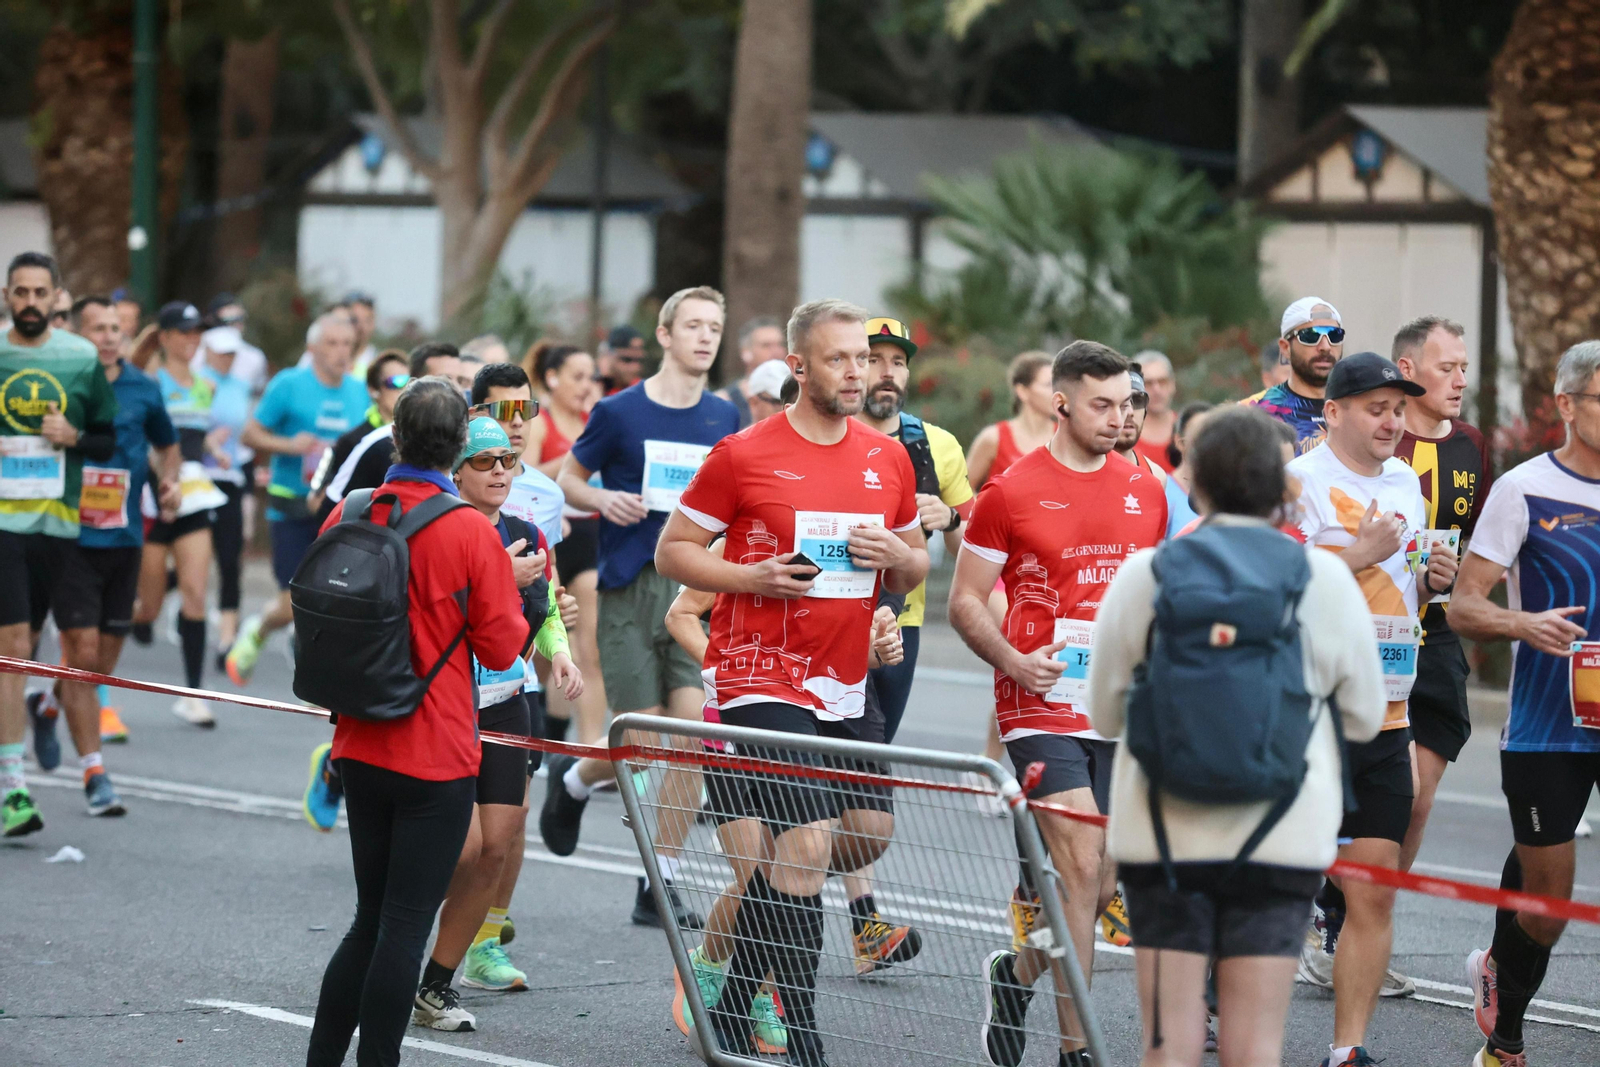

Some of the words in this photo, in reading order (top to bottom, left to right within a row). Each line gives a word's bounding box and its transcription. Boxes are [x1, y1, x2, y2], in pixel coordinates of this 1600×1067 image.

[1075, 544, 1122, 556] GENERALI
[1077, 565, 1117, 585] MÁLAG
[1482, 975, 1490, 1009] HOKA
